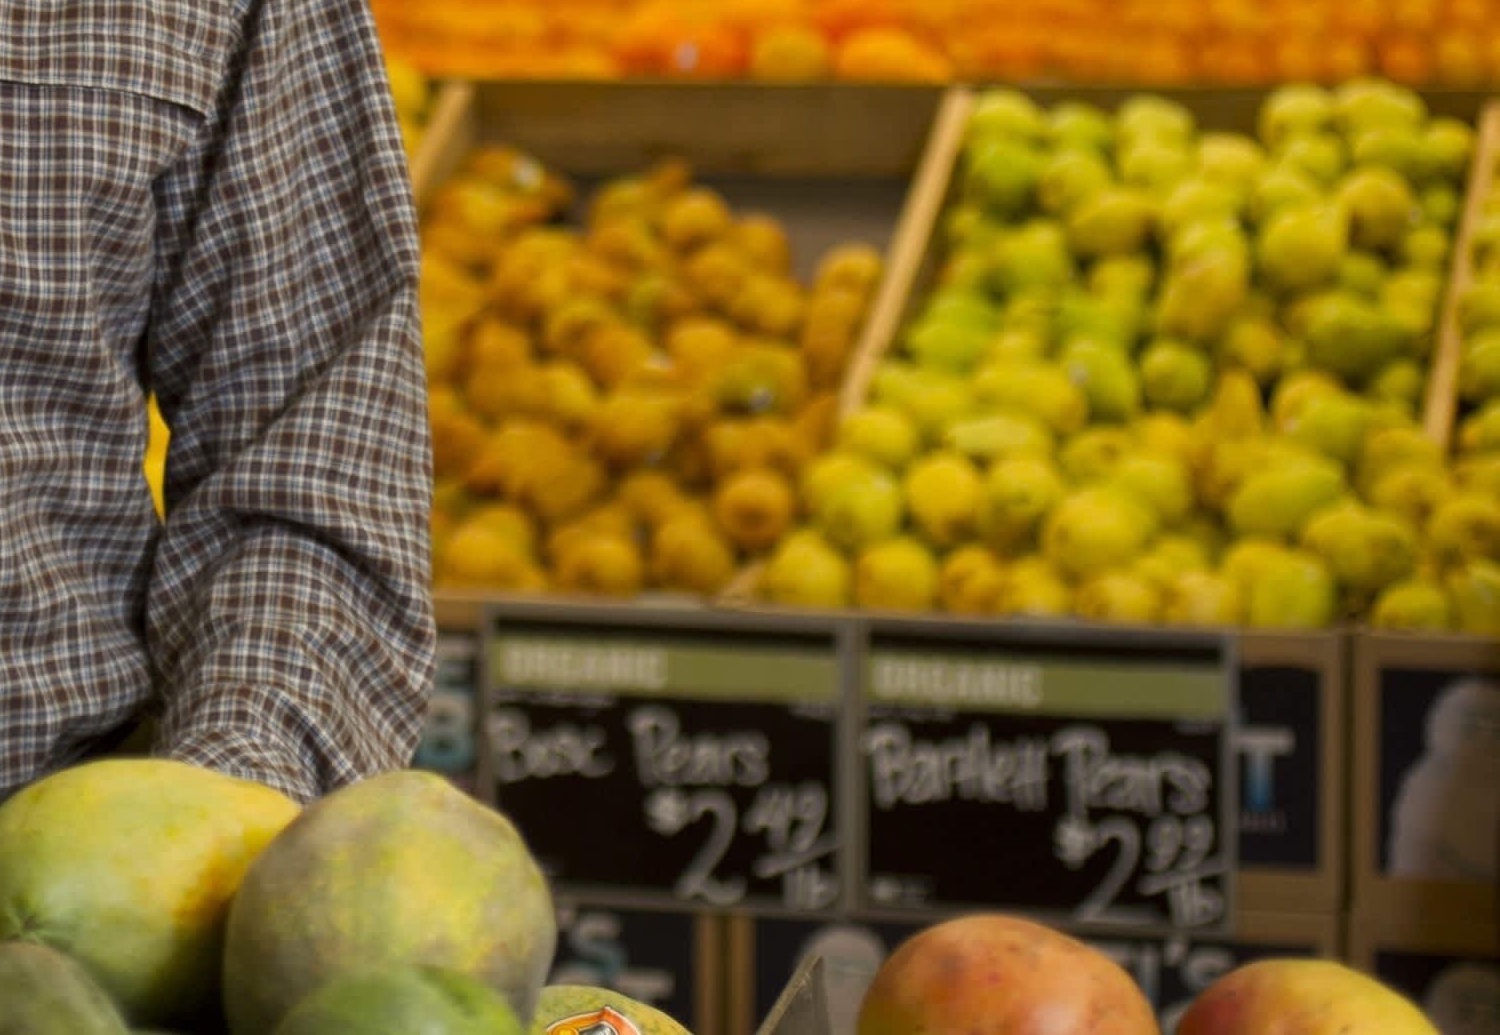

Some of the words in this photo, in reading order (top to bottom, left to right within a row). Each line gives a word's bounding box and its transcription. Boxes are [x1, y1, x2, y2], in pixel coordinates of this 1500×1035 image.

[502, 643, 668, 691] ORGANIC
[870, 661, 1043, 709] ORGANIC
[626, 706, 769, 788] Pears
[1050, 726, 1212, 818] Pears
